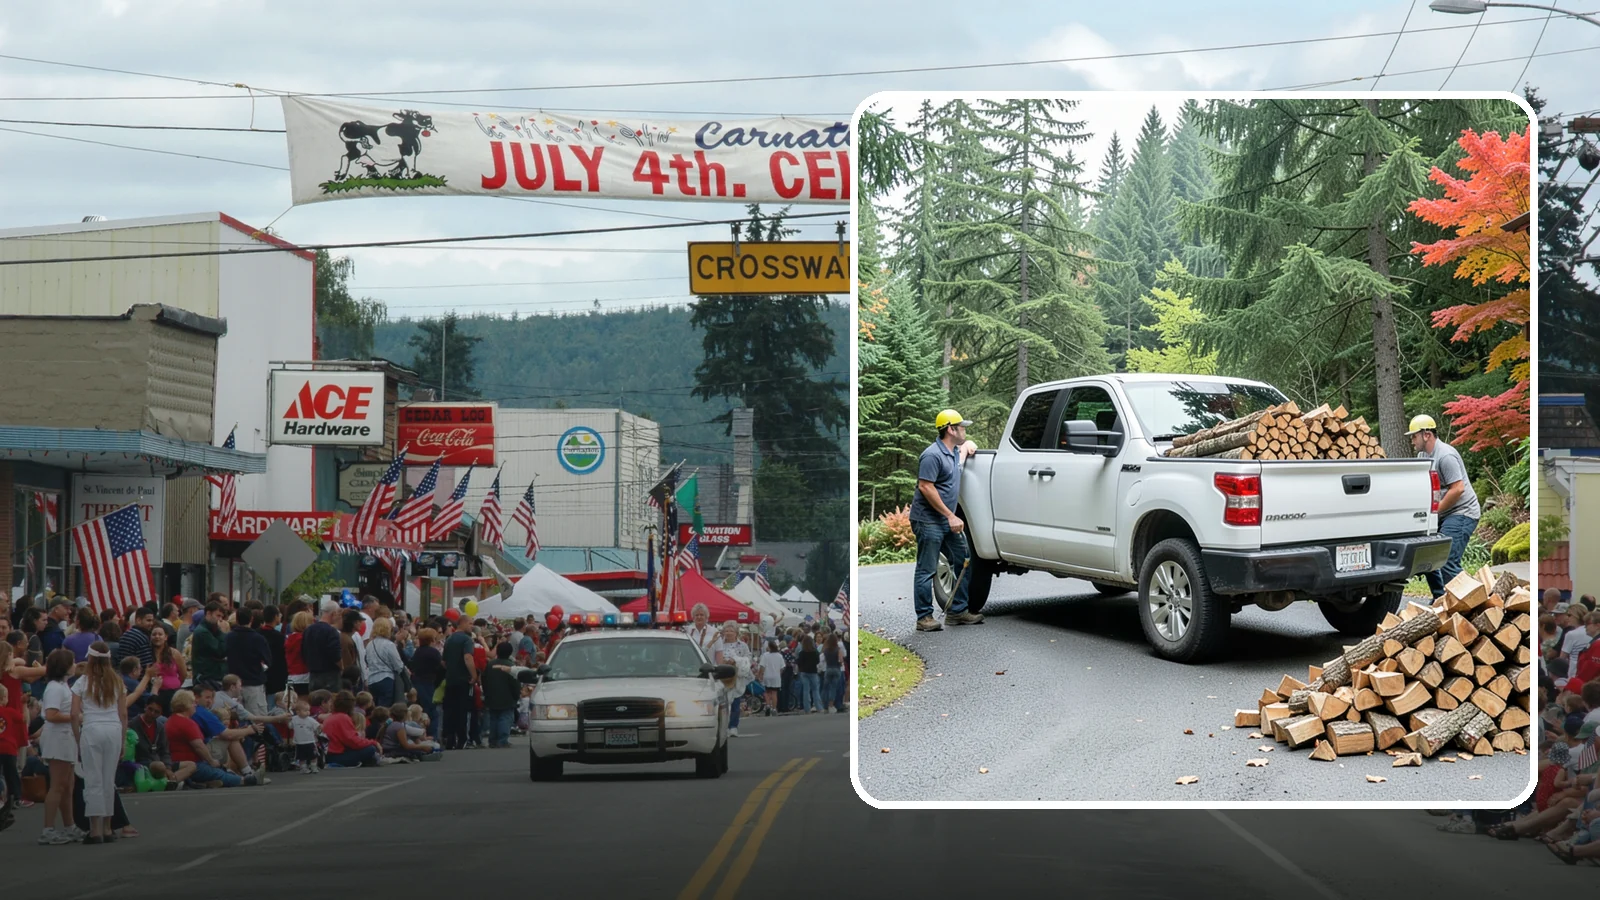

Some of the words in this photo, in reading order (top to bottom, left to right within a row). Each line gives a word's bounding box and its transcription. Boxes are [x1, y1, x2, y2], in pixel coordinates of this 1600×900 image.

[695, 122, 850, 149] Carnat
[481, 141, 604, 192] JULY
[632, 150, 746, 197] 4th.
[697, 254, 850, 279] CROSSWA
[282, 380, 373, 420] ACE
[405, 409, 452, 422] CEDAR
[283, 421, 370, 436] Hardware
[416, 428, 476, 447] Coca-Cola
[353, 467, 386, 478] Simpl
[96, 485, 124, 494] Vincent
[126, 486, 136, 495] de
[138, 486, 155, 495] Paul
[81, 503, 153, 522] THT
[688, 527, 741, 535] CRNATION
[699, 535, 730, 543] GLASS
